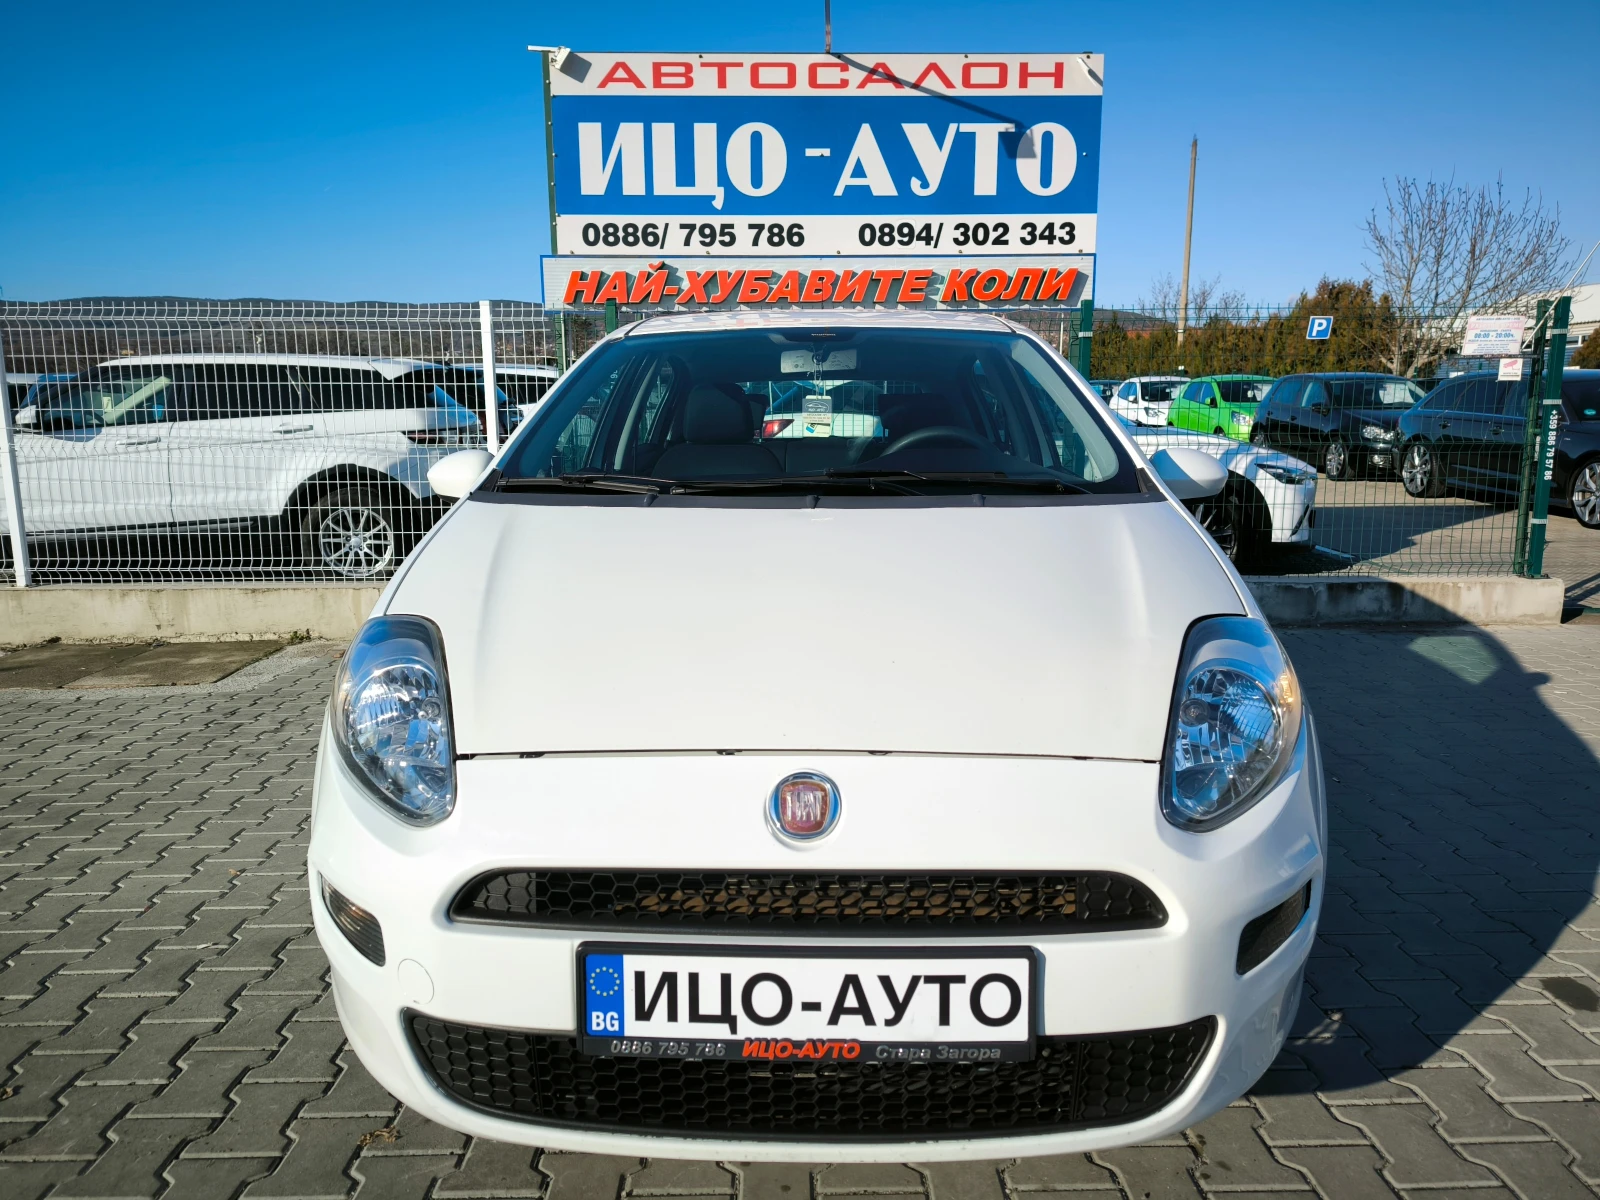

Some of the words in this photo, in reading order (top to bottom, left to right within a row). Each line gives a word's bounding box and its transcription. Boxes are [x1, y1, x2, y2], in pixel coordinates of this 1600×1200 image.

[598, 61, 1065, 90] АВТОСАЛОН
[582, 222, 669, 249] 0886/
[679, 223, 737, 247] 795
[748, 223, 805, 247] 786
[858, 222, 944, 249] 0894/
[952, 222, 1010, 247] 302
[1019, 221, 1076, 246] 343
[563, 261, 933, 304] НАЙ-ХУБАВИТЕ
[942, 267, 1078, 302] КОЛИ
[1311, 318, 1327, 337] P
[1548, 409, 1558, 430] +359
[1547, 431, 1557, 446] 886
[1546, 447, 1555, 457] 79
[1545, 459, 1553, 469] 57
[1544, 470, 1552, 481] 86
[634, 970, 1022, 1035] ИЦО-АУТО
[592, 1011, 619, 1031] BG
[611, 1040, 652, 1055] 0886
[658, 1041, 690, 1056] 795
[694, 1042, 727, 1057] 786
[741, 1040, 861, 1060] ИЦО-АУТО
[875, 1045, 932, 1061] Стара
[936, 1045, 1001, 1061] Загора
